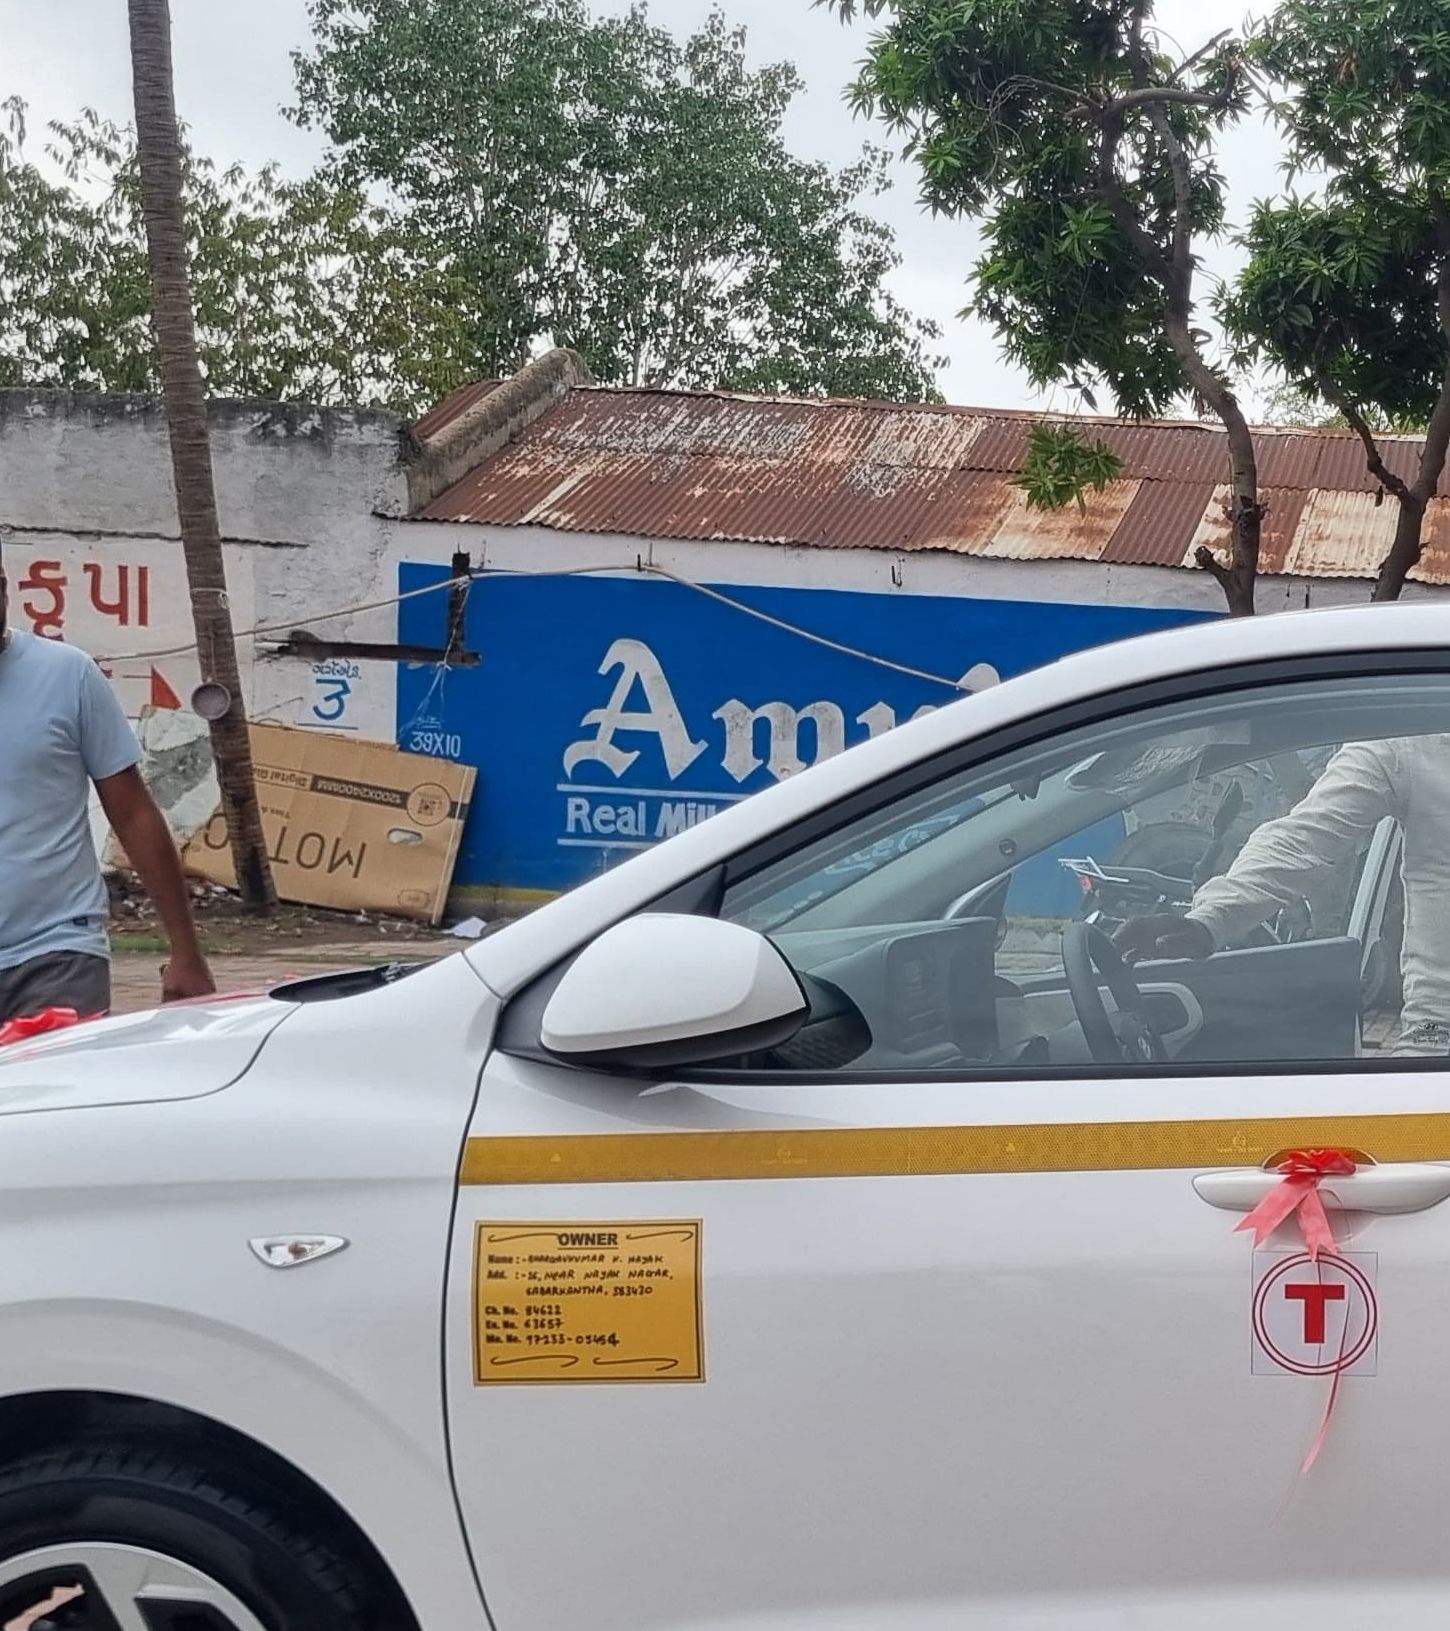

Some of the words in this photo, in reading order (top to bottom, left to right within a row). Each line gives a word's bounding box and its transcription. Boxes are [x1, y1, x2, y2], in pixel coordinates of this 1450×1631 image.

[562, 638, 1000, 783] Am
[566, 798, 643, 837] Real
[558, 1233, 618, 1246] OWNER
[1284, 1283, 1345, 1344] T
